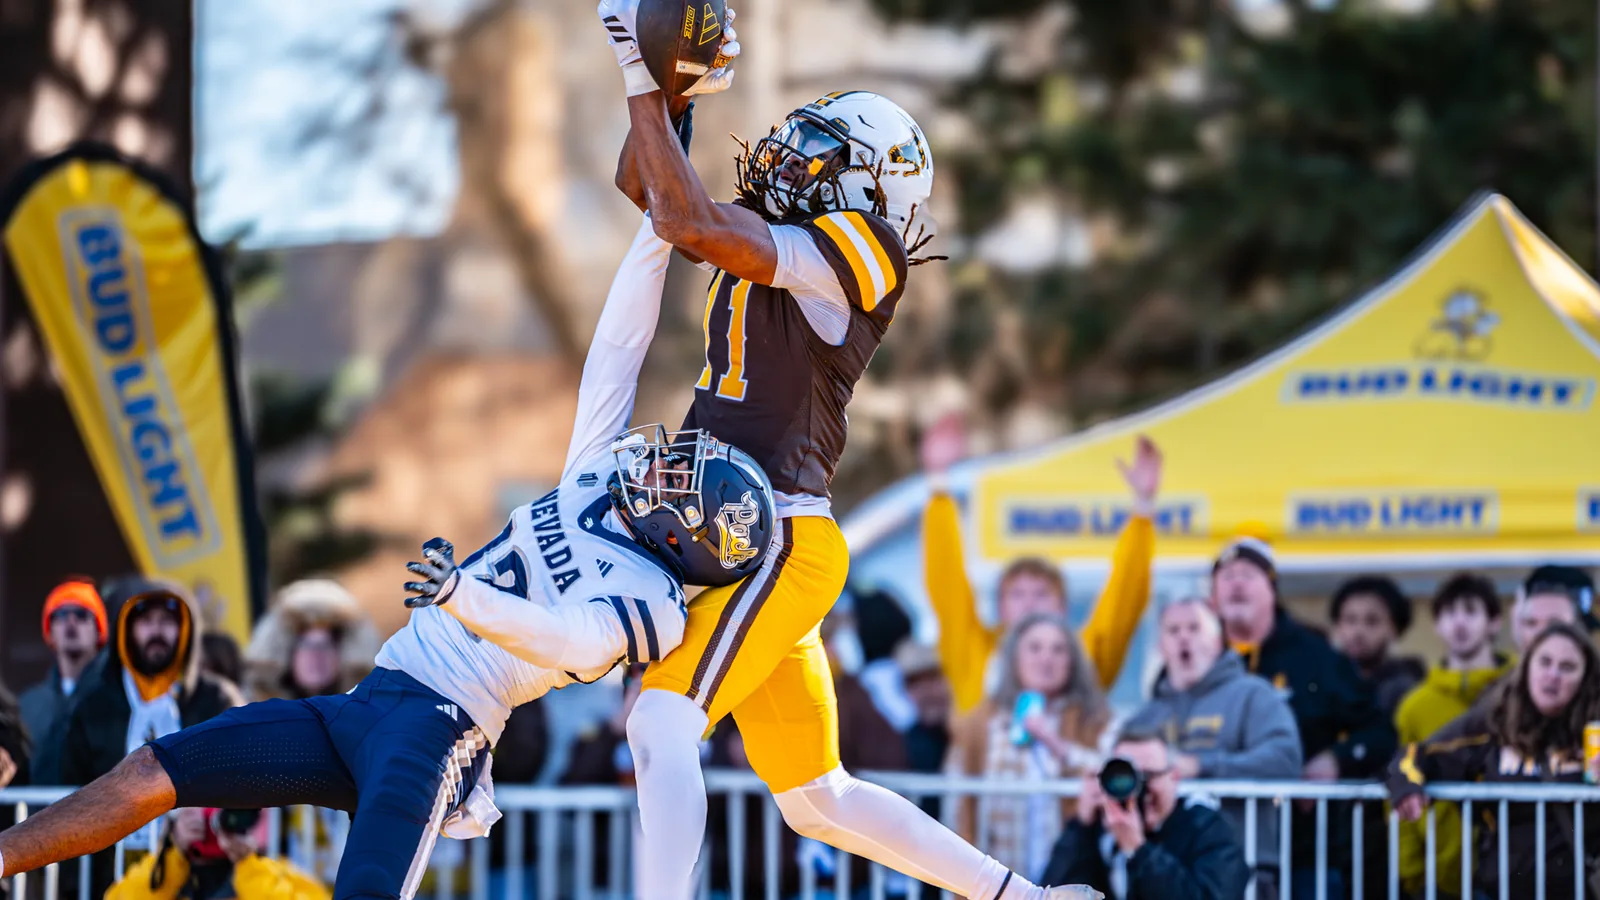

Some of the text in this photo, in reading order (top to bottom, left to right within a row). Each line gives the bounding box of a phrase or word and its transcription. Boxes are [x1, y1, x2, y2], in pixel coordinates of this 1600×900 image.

[684, 5, 696, 39] DIME
[78, 226, 202, 539] BUD LIGHT
[1299, 367, 1575, 405] BUD LIGHT
[714, 491, 759, 569] Pack
[1009, 502, 1193, 536] BUD LIHT
[1297, 498, 1486, 530] BUD LIGHT
[530, 487, 583, 596] NEVADA
